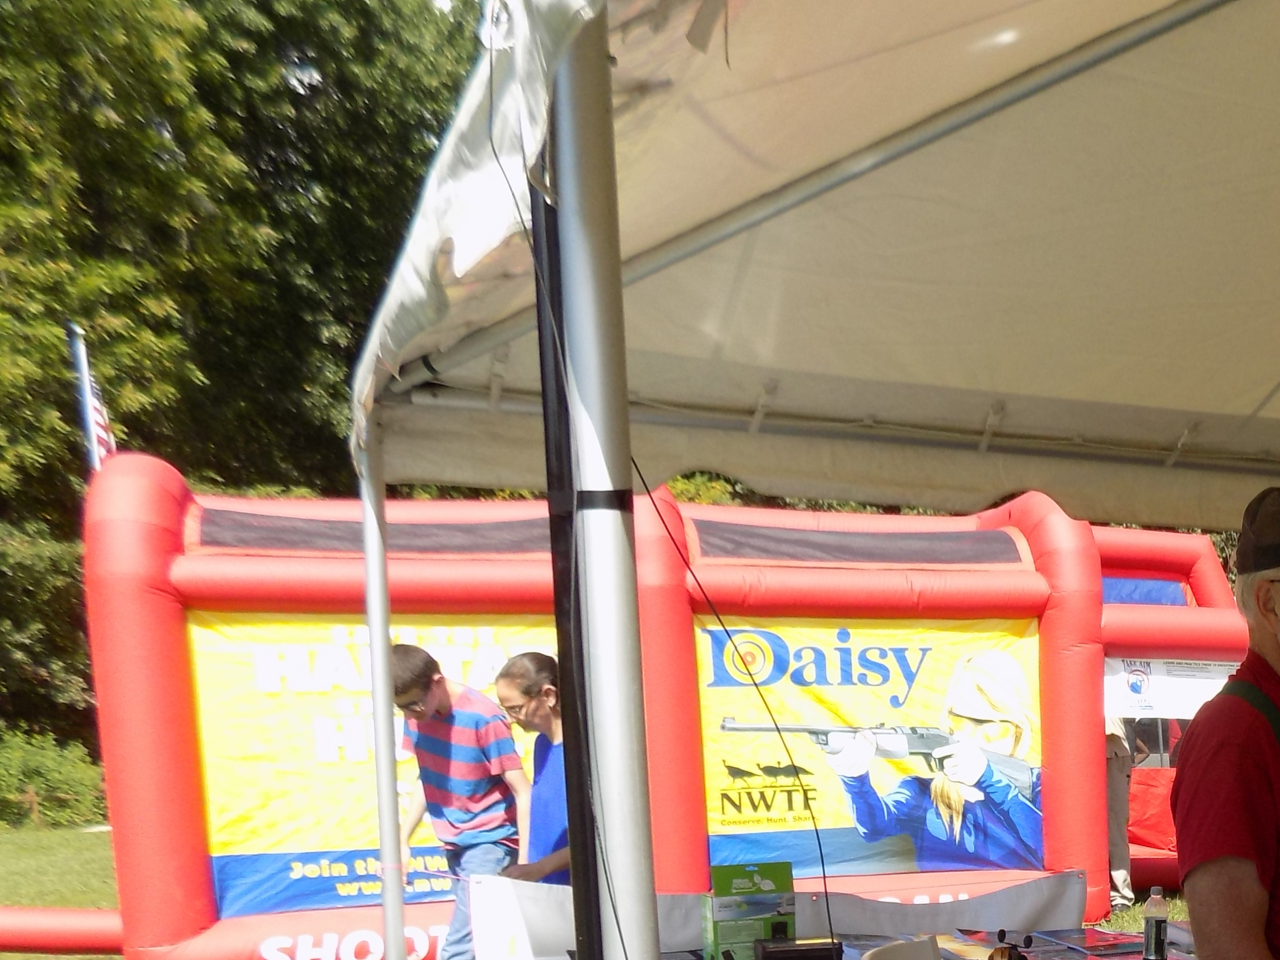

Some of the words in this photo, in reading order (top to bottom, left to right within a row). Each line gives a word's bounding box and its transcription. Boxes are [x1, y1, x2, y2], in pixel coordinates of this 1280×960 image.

[701, 628, 932, 709] Daisy
[720, 788, 817, 815] NWTF
[720, 818, 763, 827] Conserve.
[766, 816, 789, 825] Hunt.
[289, 858, 348, 879] Join
